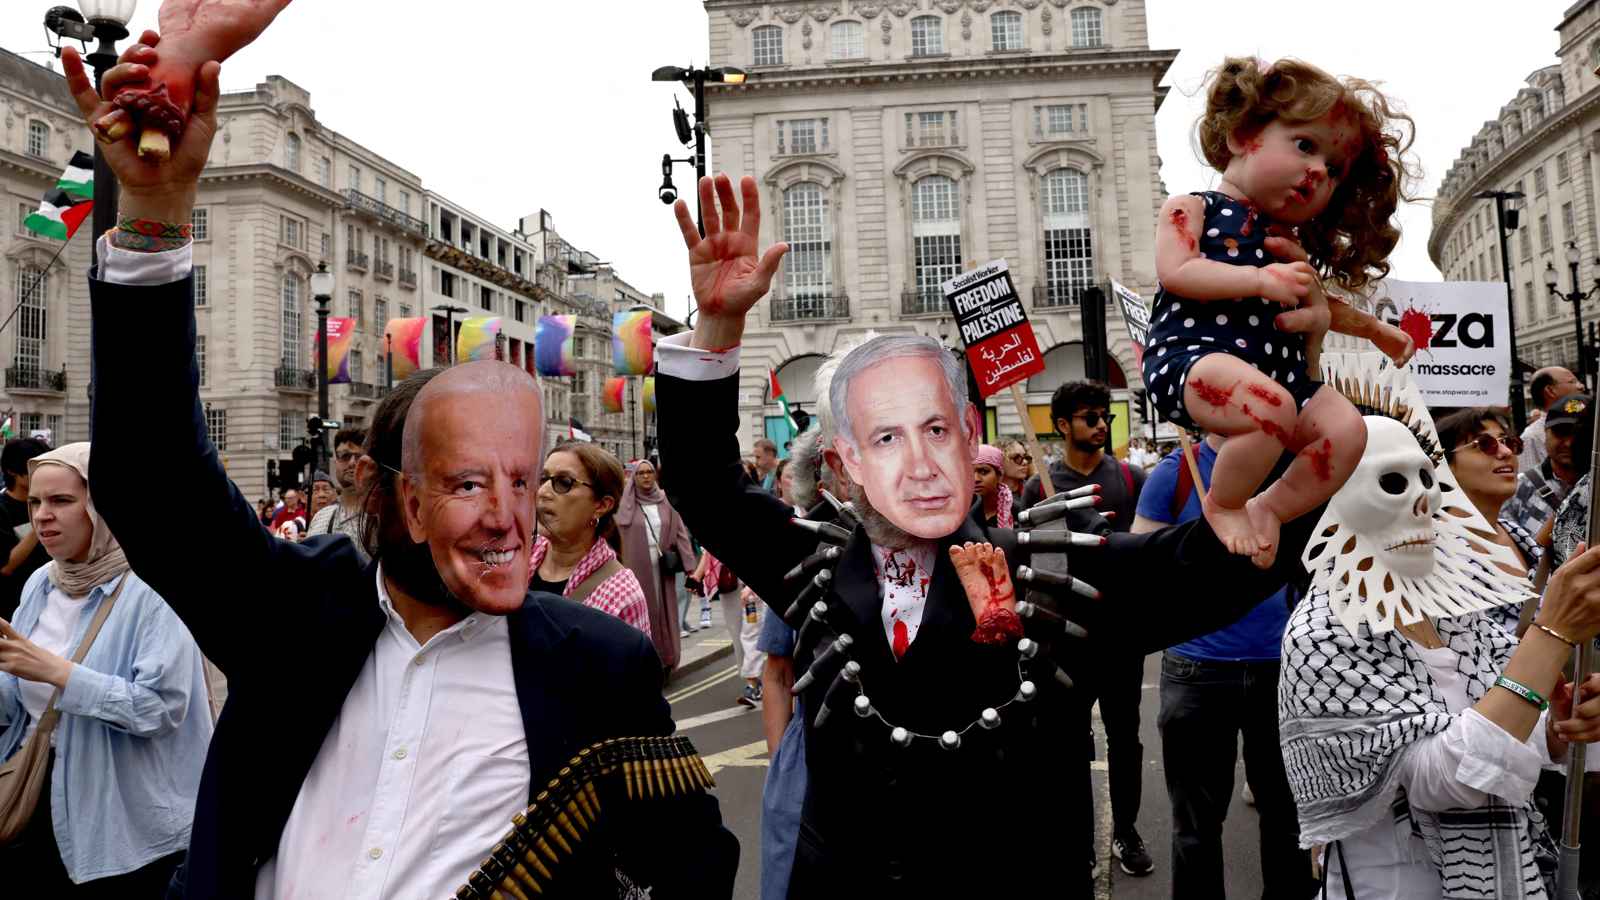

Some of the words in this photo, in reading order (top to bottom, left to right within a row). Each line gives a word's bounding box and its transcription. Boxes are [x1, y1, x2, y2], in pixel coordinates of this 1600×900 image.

[952, 274, 976, 290] Socialist
[975, 266, 999, 279] Worker
[954, 276, 1011, 315] FREEDOM
[981, 305, 992, 314] for
[961, 302, 1024, 344] PALESTINE
[1122, 298, 1148, 325] FREE
[1375, 297, 1495, 349] Gza
[980, 333, 1021, 361] الحرية
[986, 347, 1035, 385] لفلسطين
[1417, 364, 1495, 376] massacre
